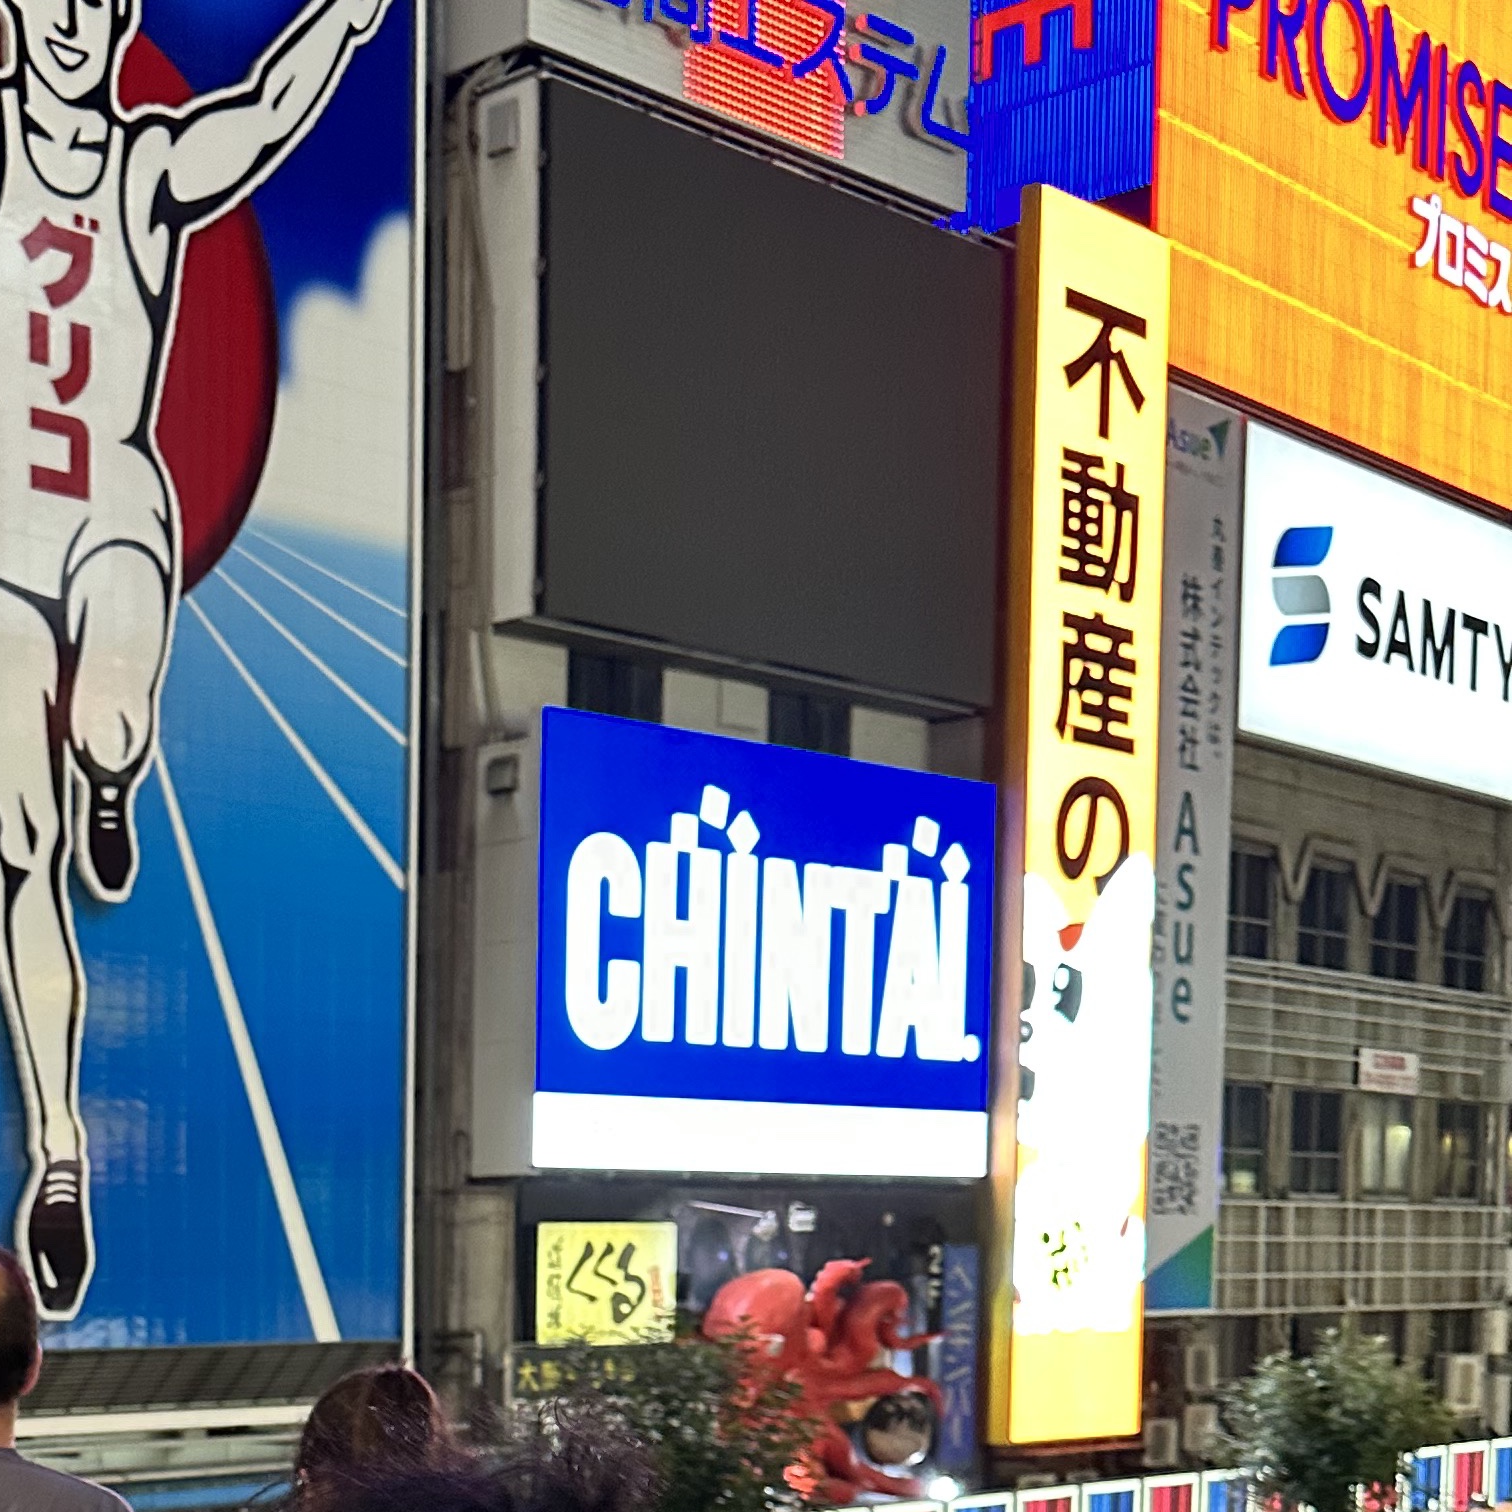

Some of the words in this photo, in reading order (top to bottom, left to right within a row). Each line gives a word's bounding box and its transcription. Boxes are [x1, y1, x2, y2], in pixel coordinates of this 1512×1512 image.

[20, 213, 101, 502] グリコ
[1055, 286, 1147, 896] 不動産の
[1354, 576, 1512, 702] SAMTY
[1171, 791, 1200, 1025] Asue
[566, 1240, 646, 1324] くくる
